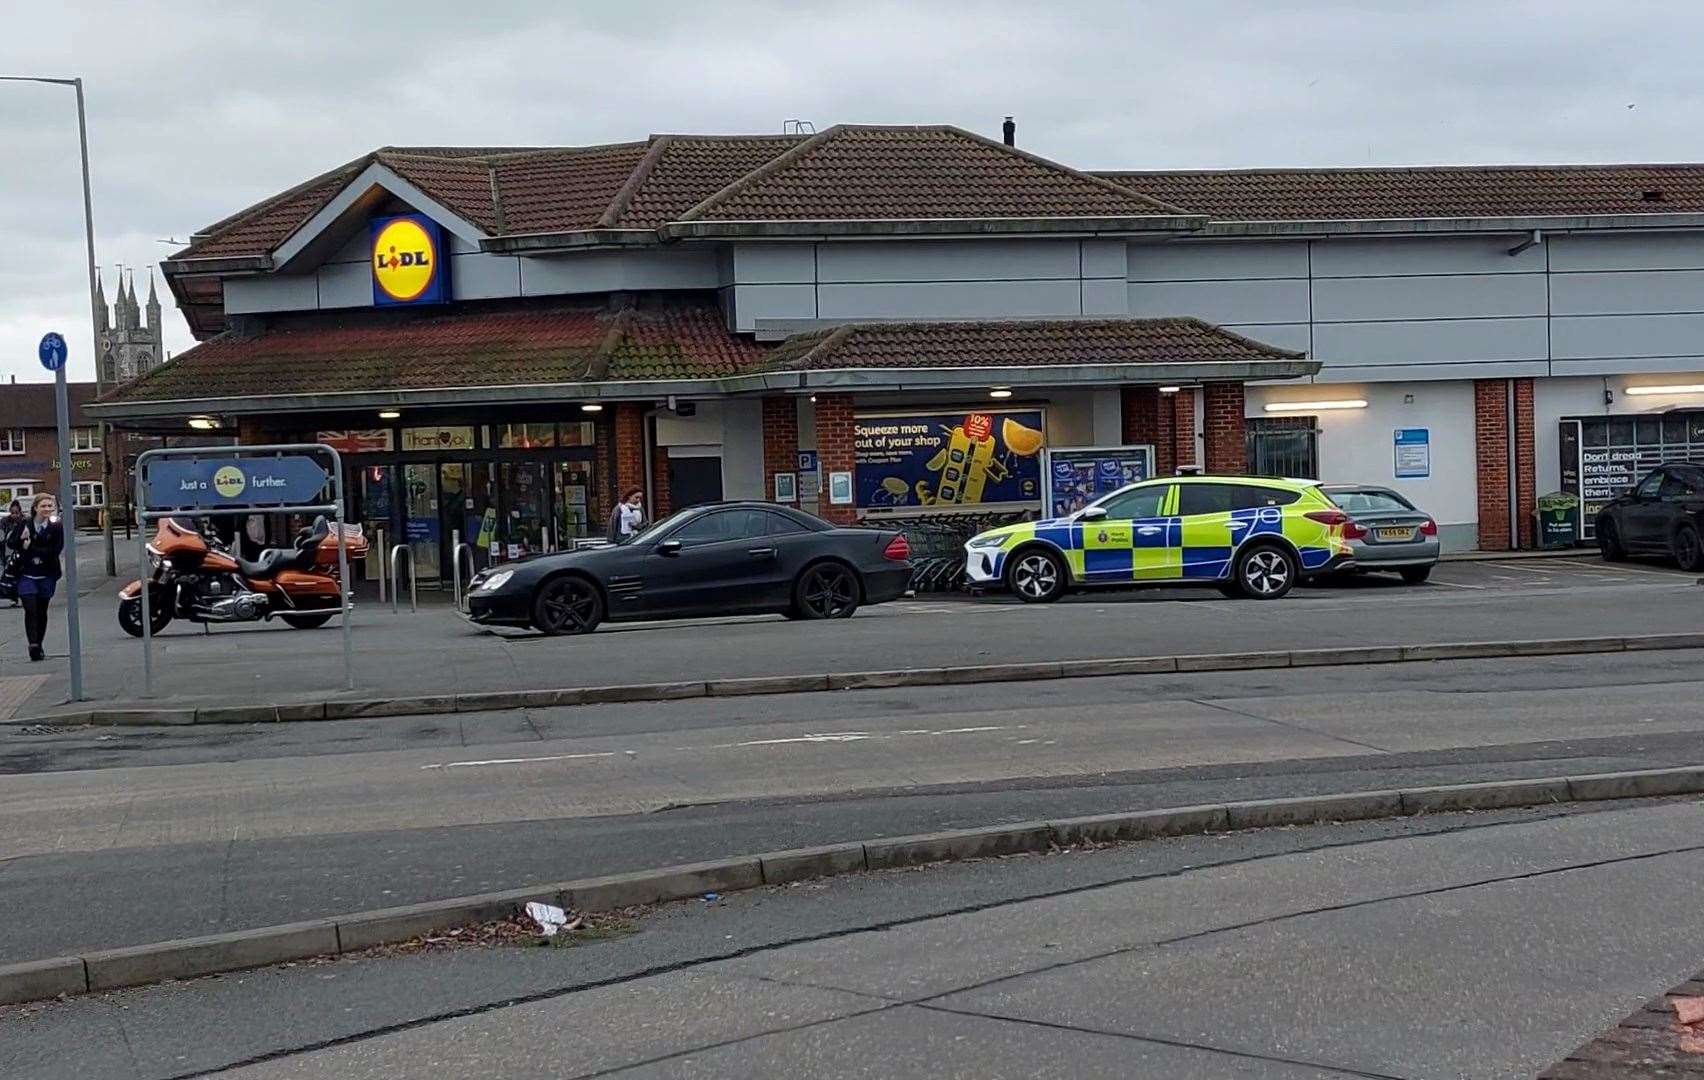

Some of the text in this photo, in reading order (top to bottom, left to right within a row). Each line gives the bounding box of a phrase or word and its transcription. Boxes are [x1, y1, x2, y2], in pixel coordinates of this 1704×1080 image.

[854, 425, 929, 437] Squeeze more
[855, 436, 940, 449] out of your shop
[1611, 452, 1642, 461] dread
[1584, 475, 1628, 484] embrace
[180, 480, 198, 490] Just
